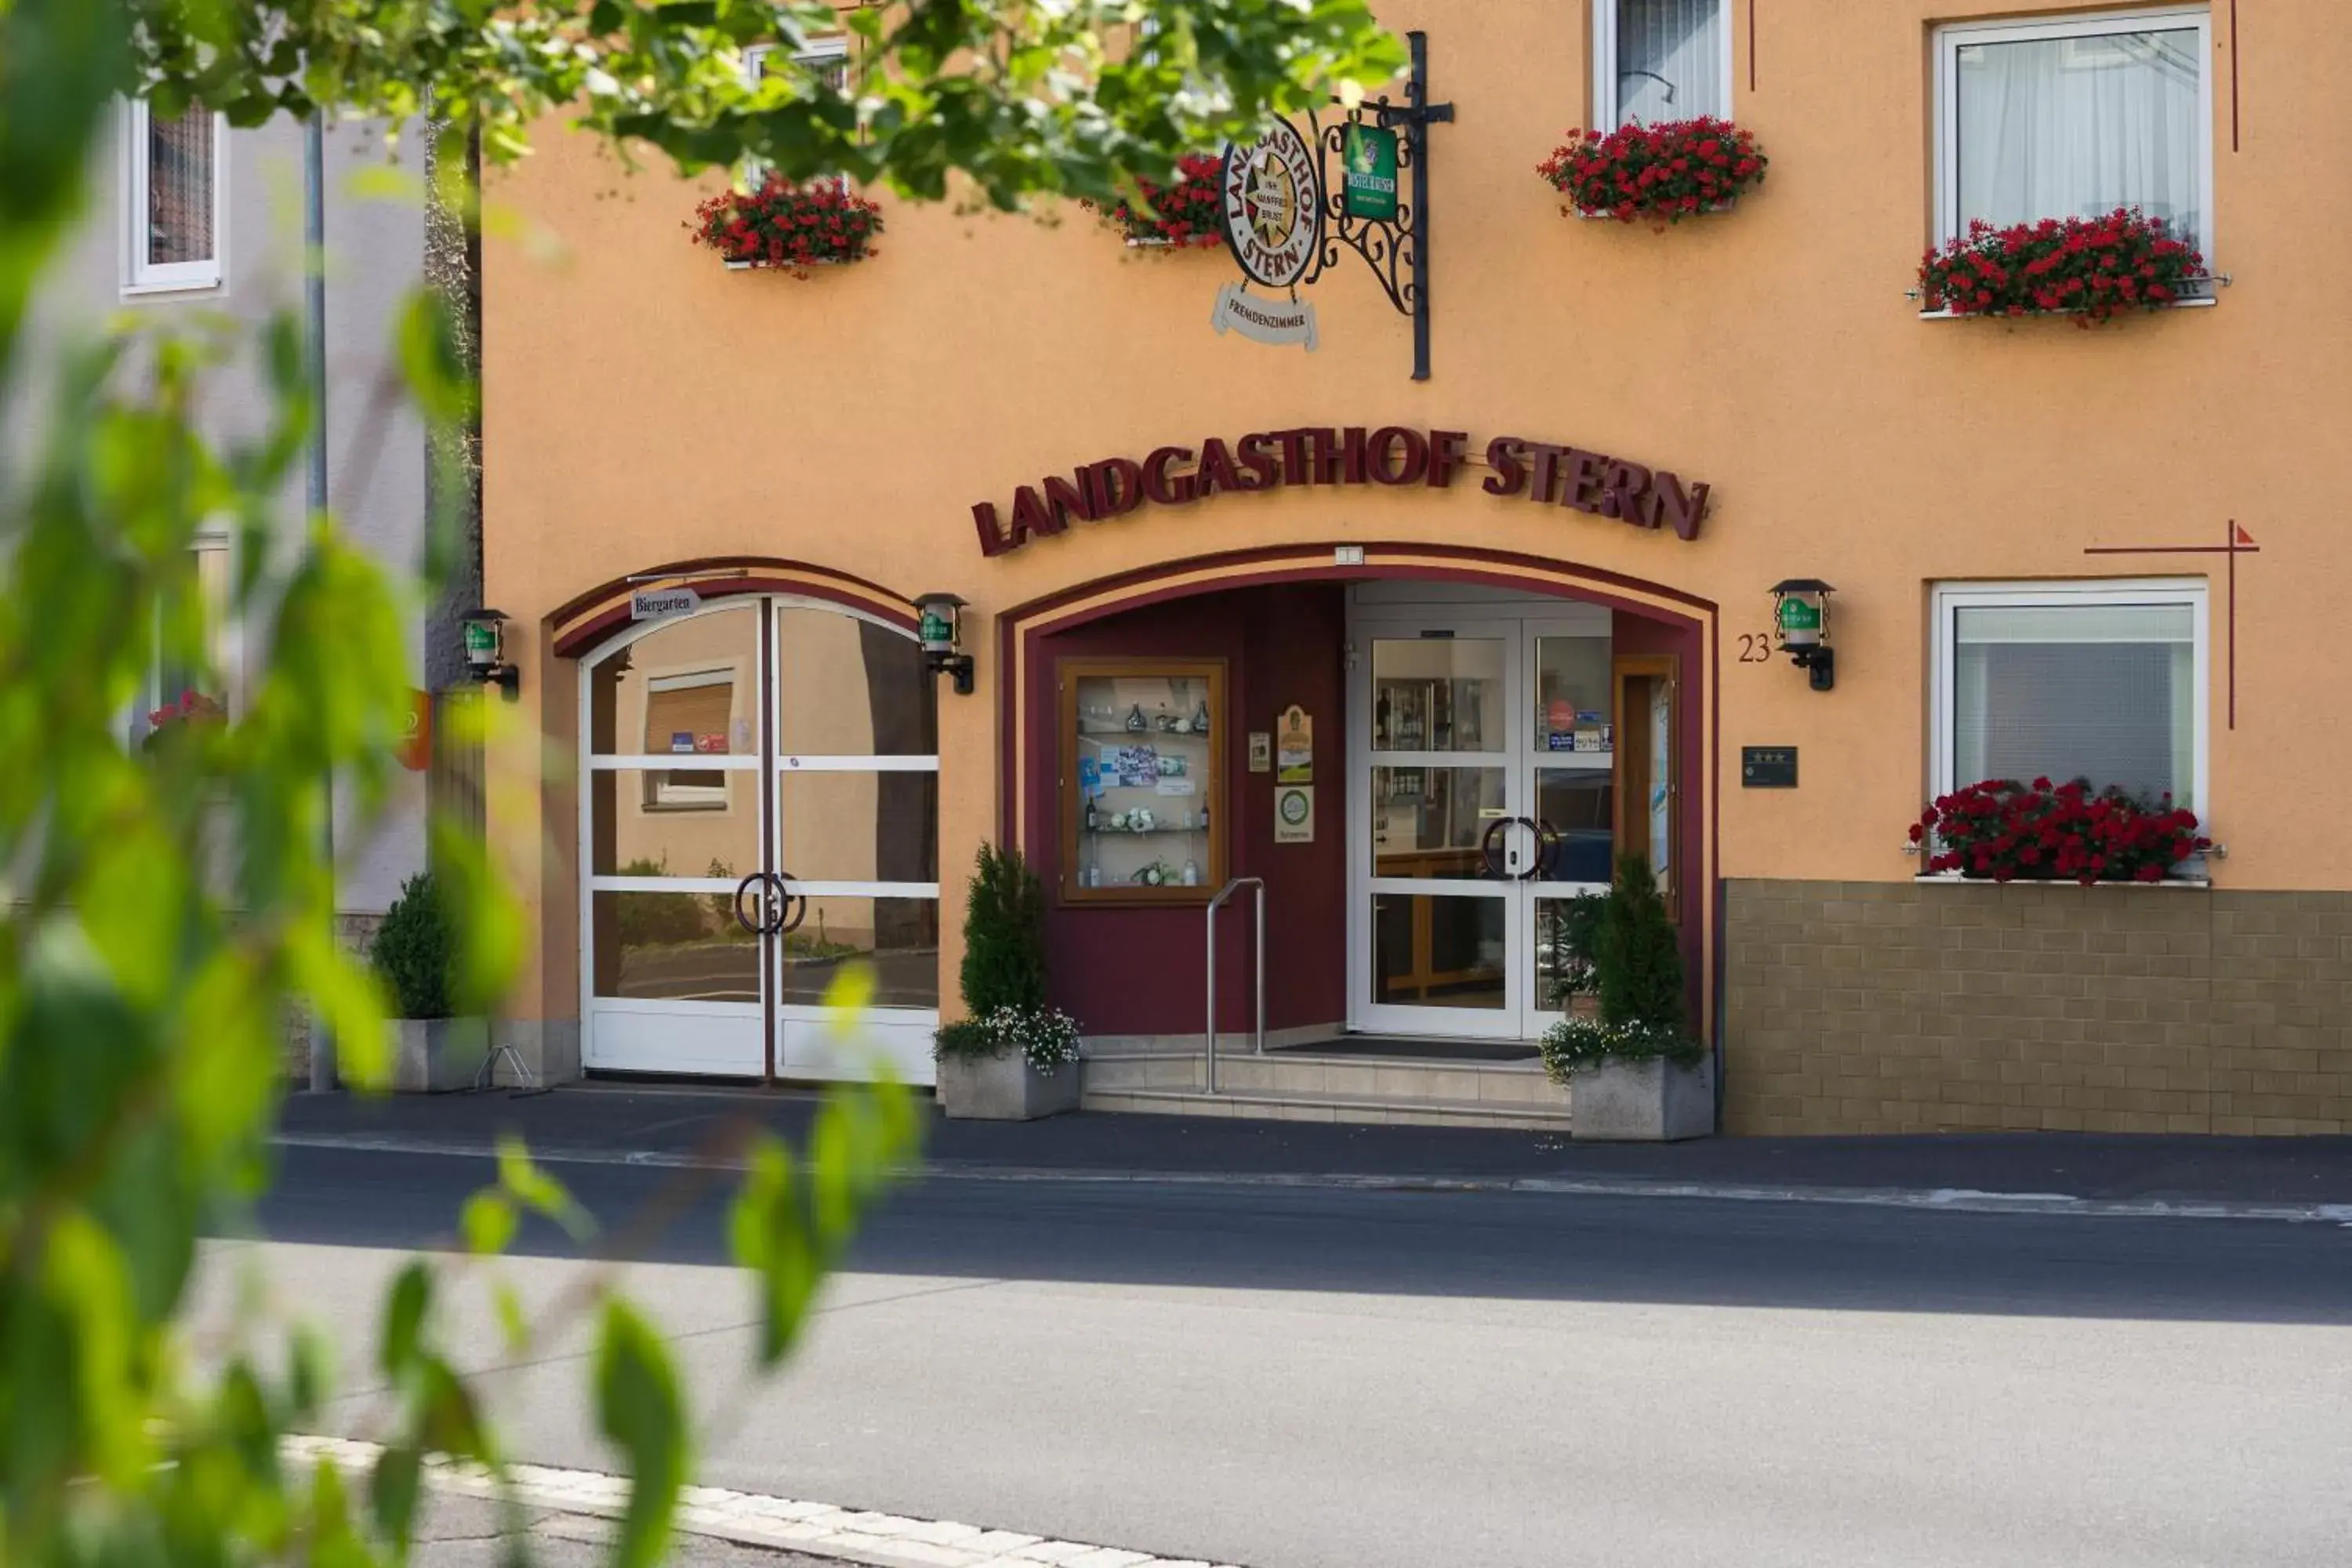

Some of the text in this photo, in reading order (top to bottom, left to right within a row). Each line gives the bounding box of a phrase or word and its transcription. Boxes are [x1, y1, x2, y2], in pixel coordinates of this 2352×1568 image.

[1243, 238, 1300, 278] STERN
[1229, 298, 1305, 328] FREMDENZIMMER
[971, 426, 1711, 557] LANDGASTHOF STERN
[636, 596, 690, 615] Biergarten
[1738, 633, 1770, 663] 23
